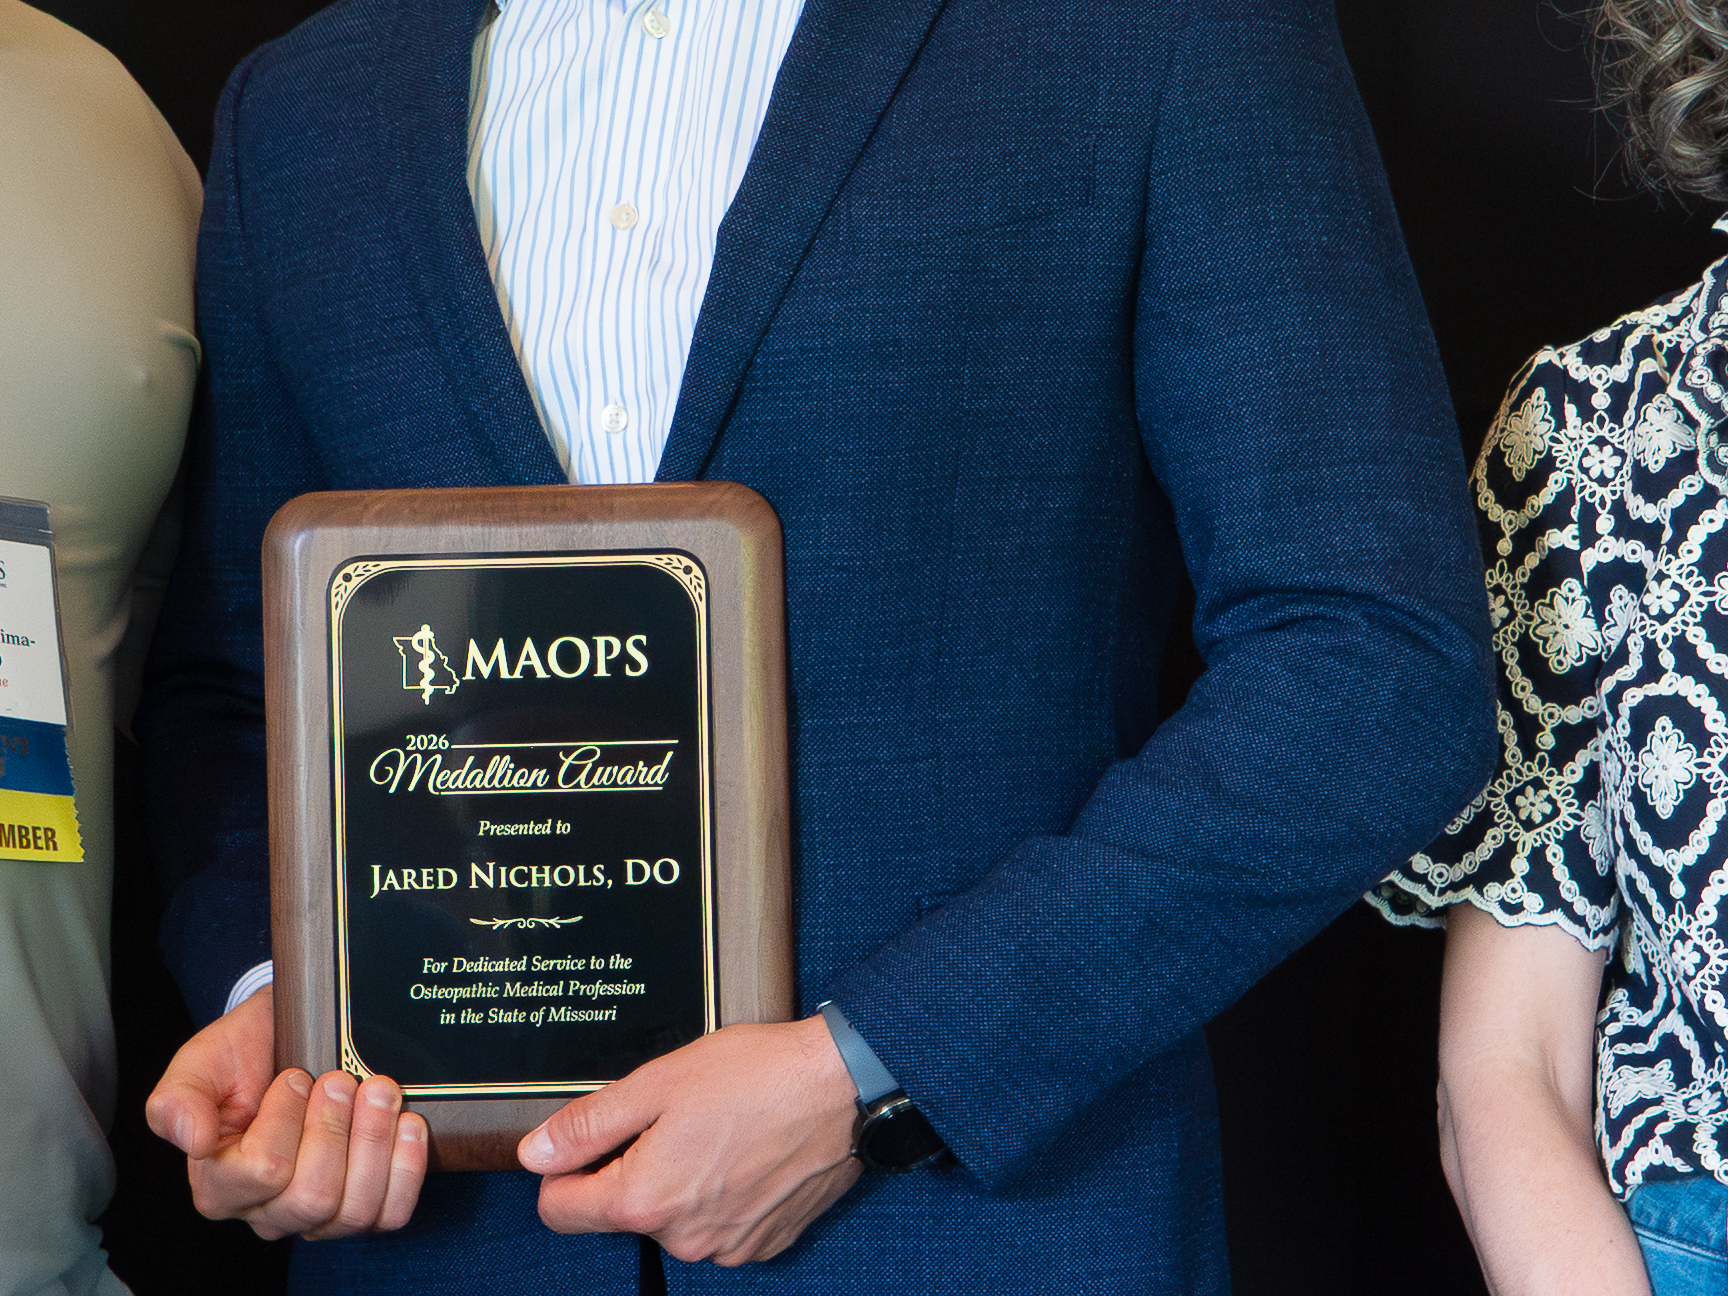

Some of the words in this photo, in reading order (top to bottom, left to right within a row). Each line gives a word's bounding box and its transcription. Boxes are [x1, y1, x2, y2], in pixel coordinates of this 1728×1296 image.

[463, 635, 648, 680] MAOPS
[406, 734, 449, 750] 2026
[370, 748, 549, 794] Medallion
[558, 746, 674, 789] Award
[478, 819, 552, 835] Presented
[556, 820, 570, 834] to
[624, 858, 679, 885] DO
[423, 958, 448, 973] For
[452, 956, 527, 972] Dedicated
[531, 955, 586, 971] Service
[590, 956, 604, 969] to
[609, 954, 632, 969] the
[410, 982, 499, 1003] Osteopathic
[503, 981, 563, 997] Medical
[568, 980, 645, 999] Profession
[441, 1009, 455, 1024] in
[461, 1008, 483, 1024] the
[488, 1008, 526, 1023] State
[530, 1007, 546, 1027] of
[547, 1006, 616, 1022] Missouri
